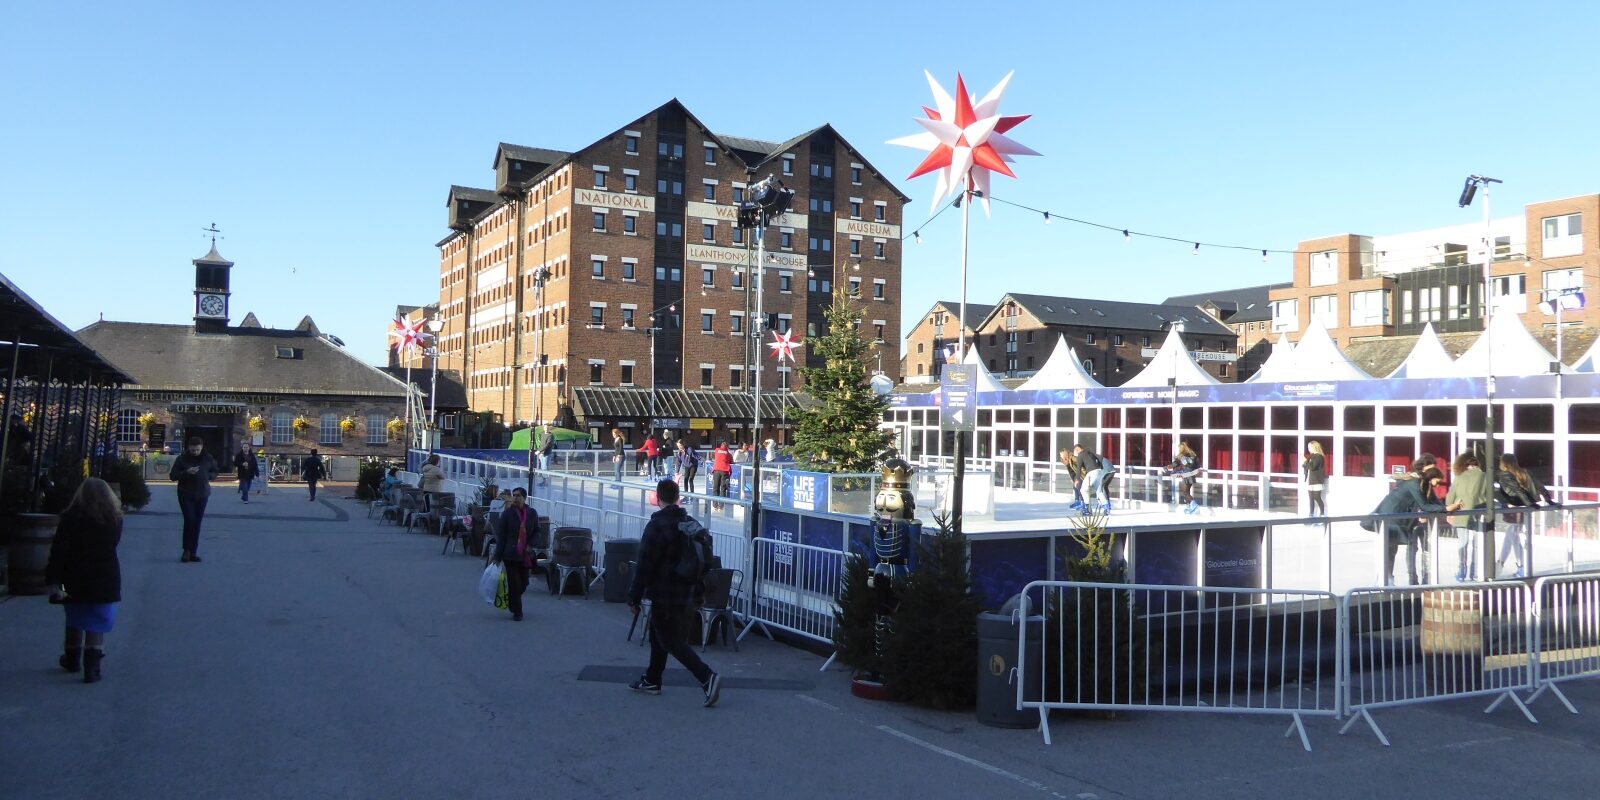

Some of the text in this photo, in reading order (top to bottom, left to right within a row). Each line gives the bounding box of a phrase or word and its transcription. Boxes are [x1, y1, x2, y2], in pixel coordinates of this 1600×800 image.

[581, 191, 649, 209] NATIONAL
[715, 206, 788, 224] WAAYS
[847, 221, 891, 236] MUSEUM
[690, 247, 746, 262] LLANTHONY
[135, 392, 155, 401] THE
[193, 393, 218, 402] HIGH
[223, 394, 280, 403] CONSTABLE
[176, 404, 241, 414] OF ENGLAND
[793, 475, 815, 492] LIFE
[793, 490, 815, 503] STYLE
[1207, 559, 1238, 569] Gloucester
